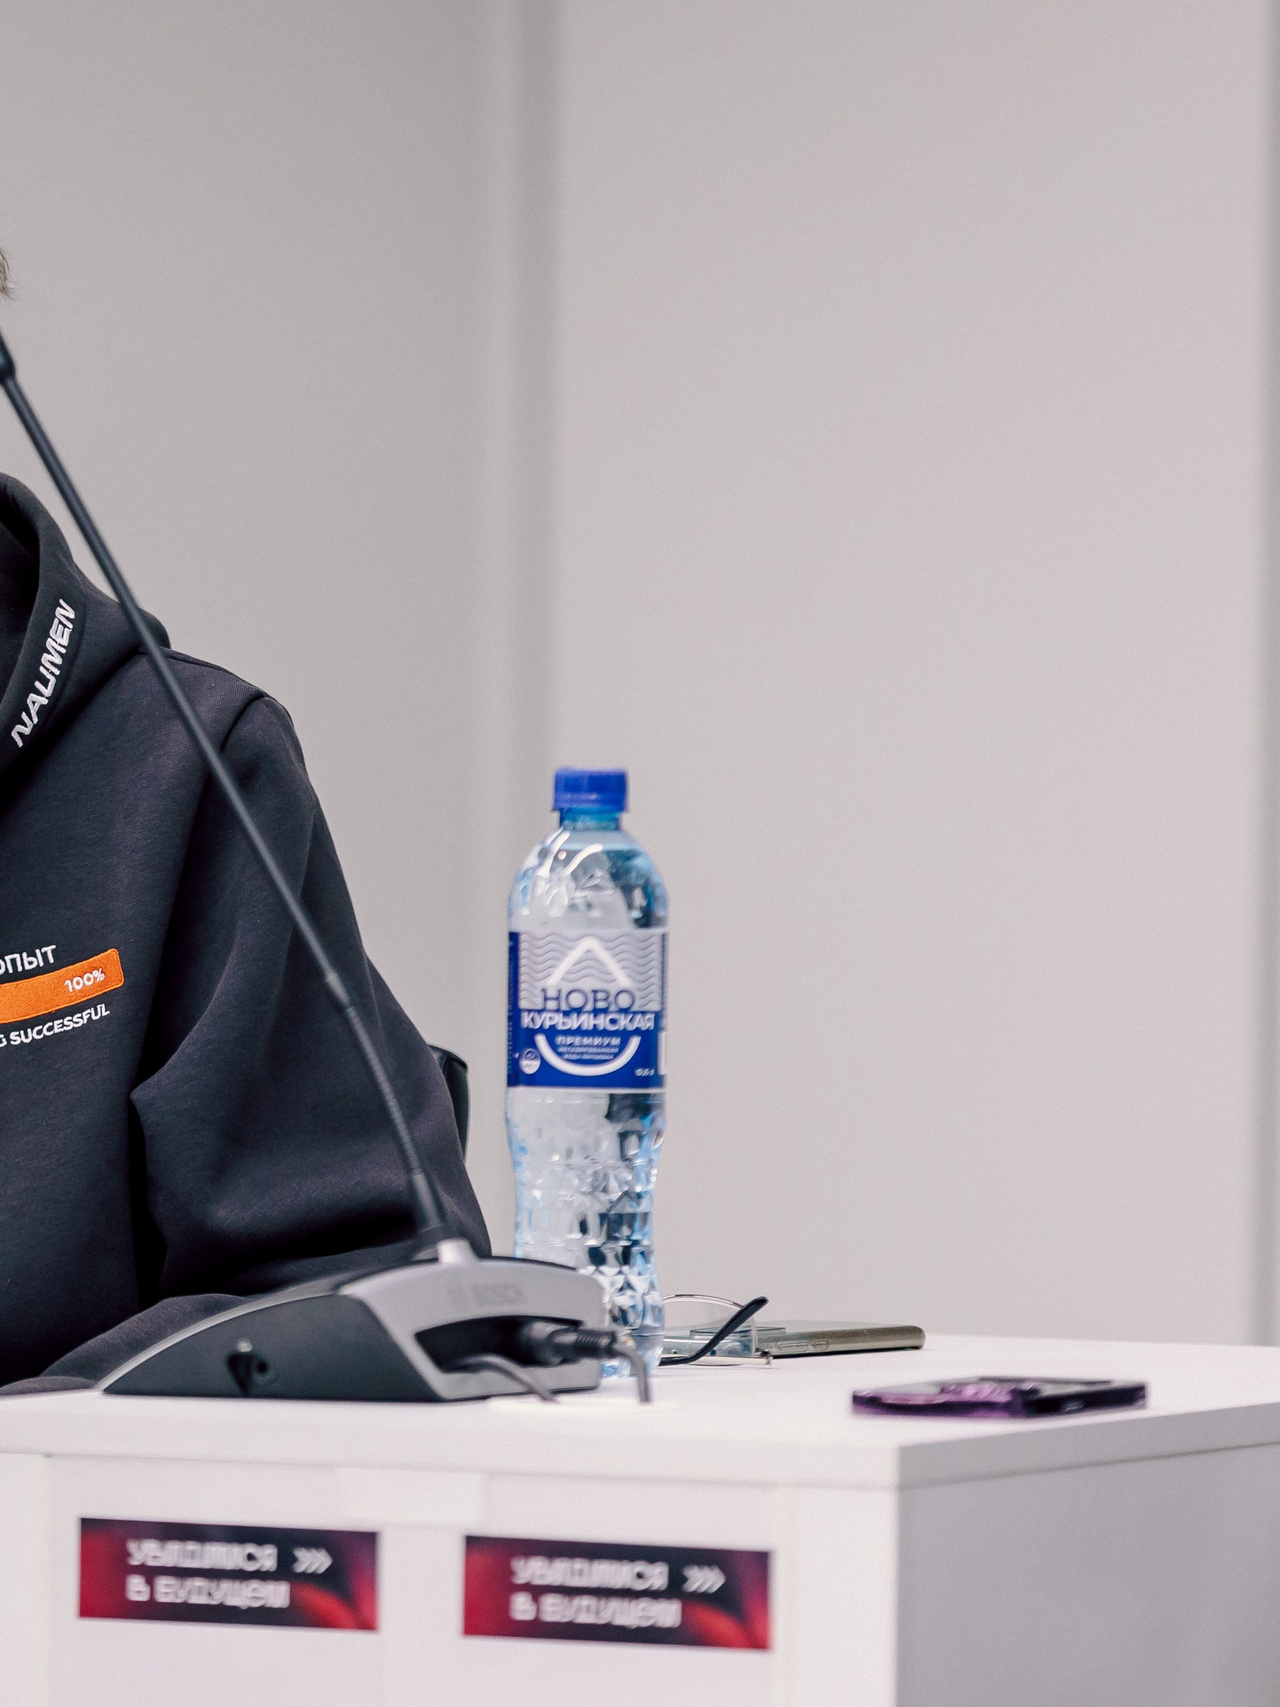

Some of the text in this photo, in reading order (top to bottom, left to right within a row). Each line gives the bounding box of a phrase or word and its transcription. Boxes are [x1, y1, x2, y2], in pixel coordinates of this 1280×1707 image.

[11, 599, 76, 748] NAUMEN
[64, 968, 106, 994] 100%
[541, 988, 635, 1011] НОВО
[9, 1003, 111, 1047] SUCCESSFUL
[521, 1011, 655, 1031] КУРЬИНСКАЯ
